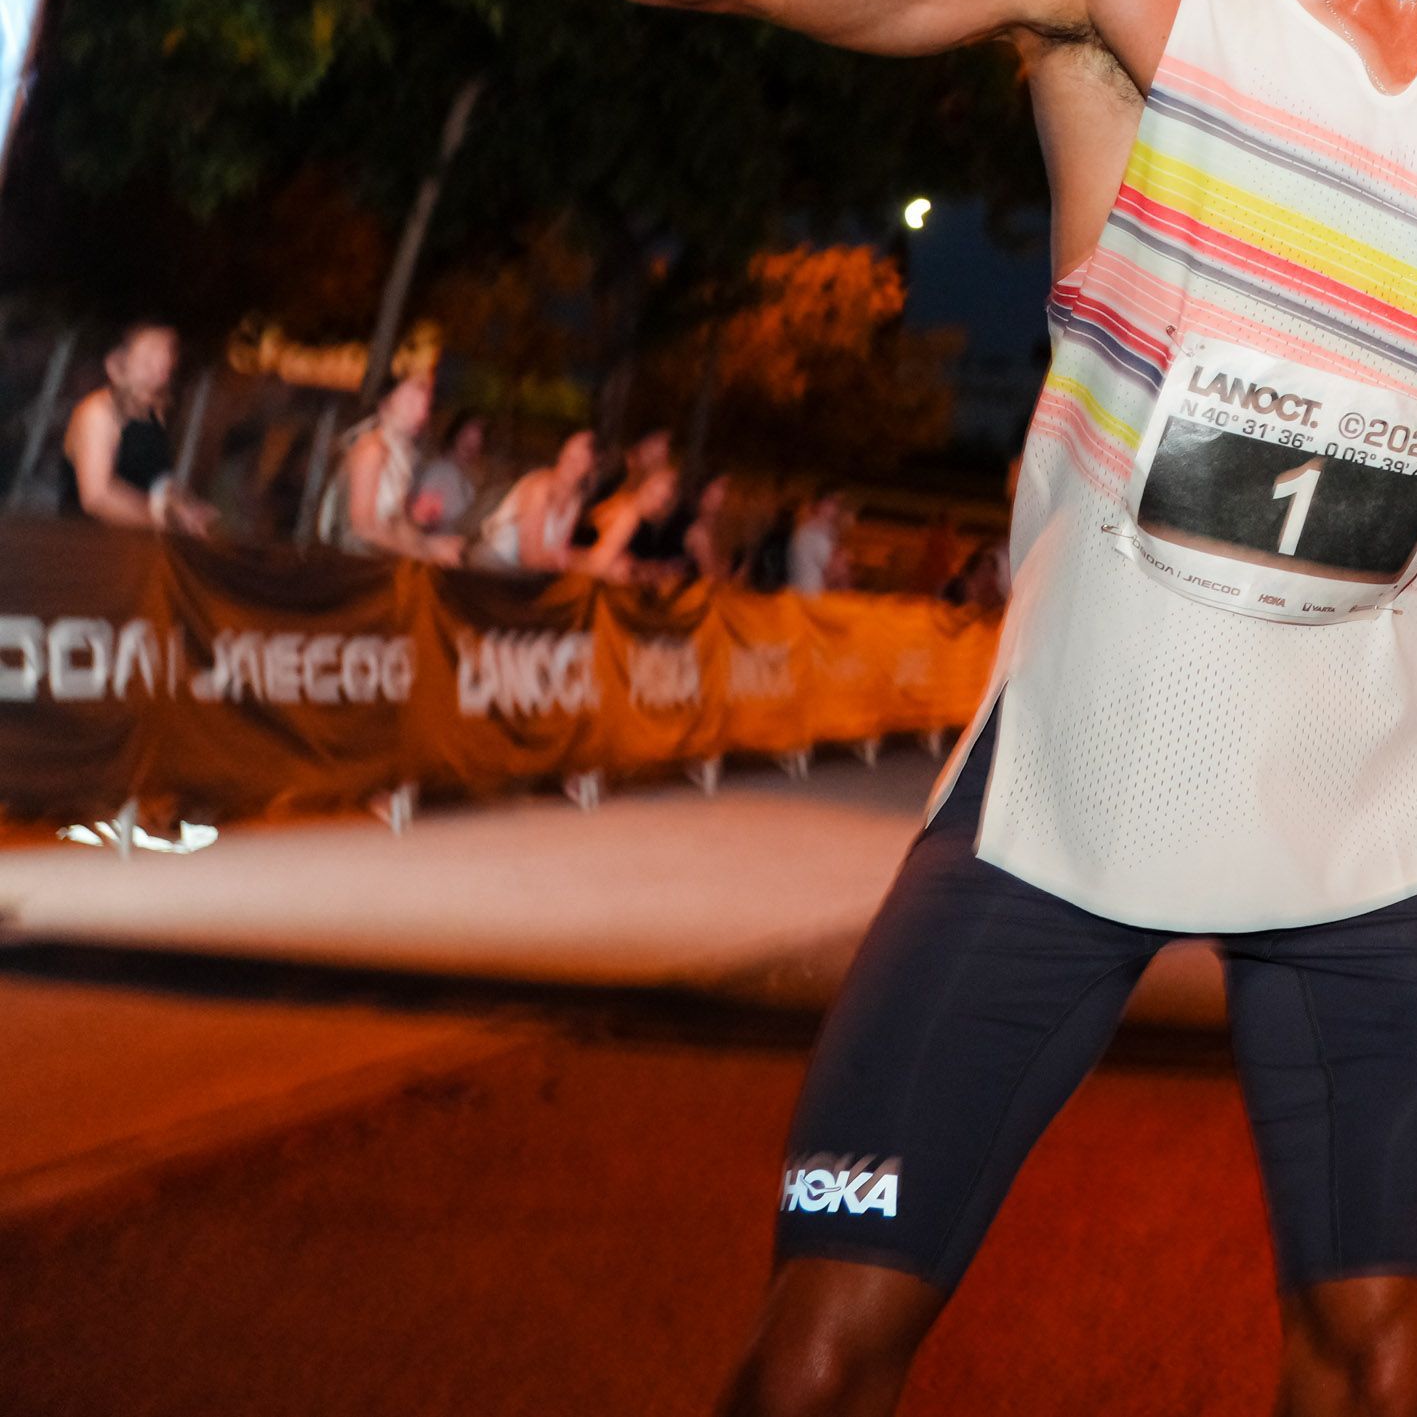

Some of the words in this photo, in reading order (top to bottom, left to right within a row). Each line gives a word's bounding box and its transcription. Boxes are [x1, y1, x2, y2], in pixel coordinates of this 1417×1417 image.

[1180, 398, 1199, 417] N
[1187, 365, 1323, 429] LANOCT.
[1272, 467, 1323, 556] 1
[780, 1168, 899, 1218] HOKA
